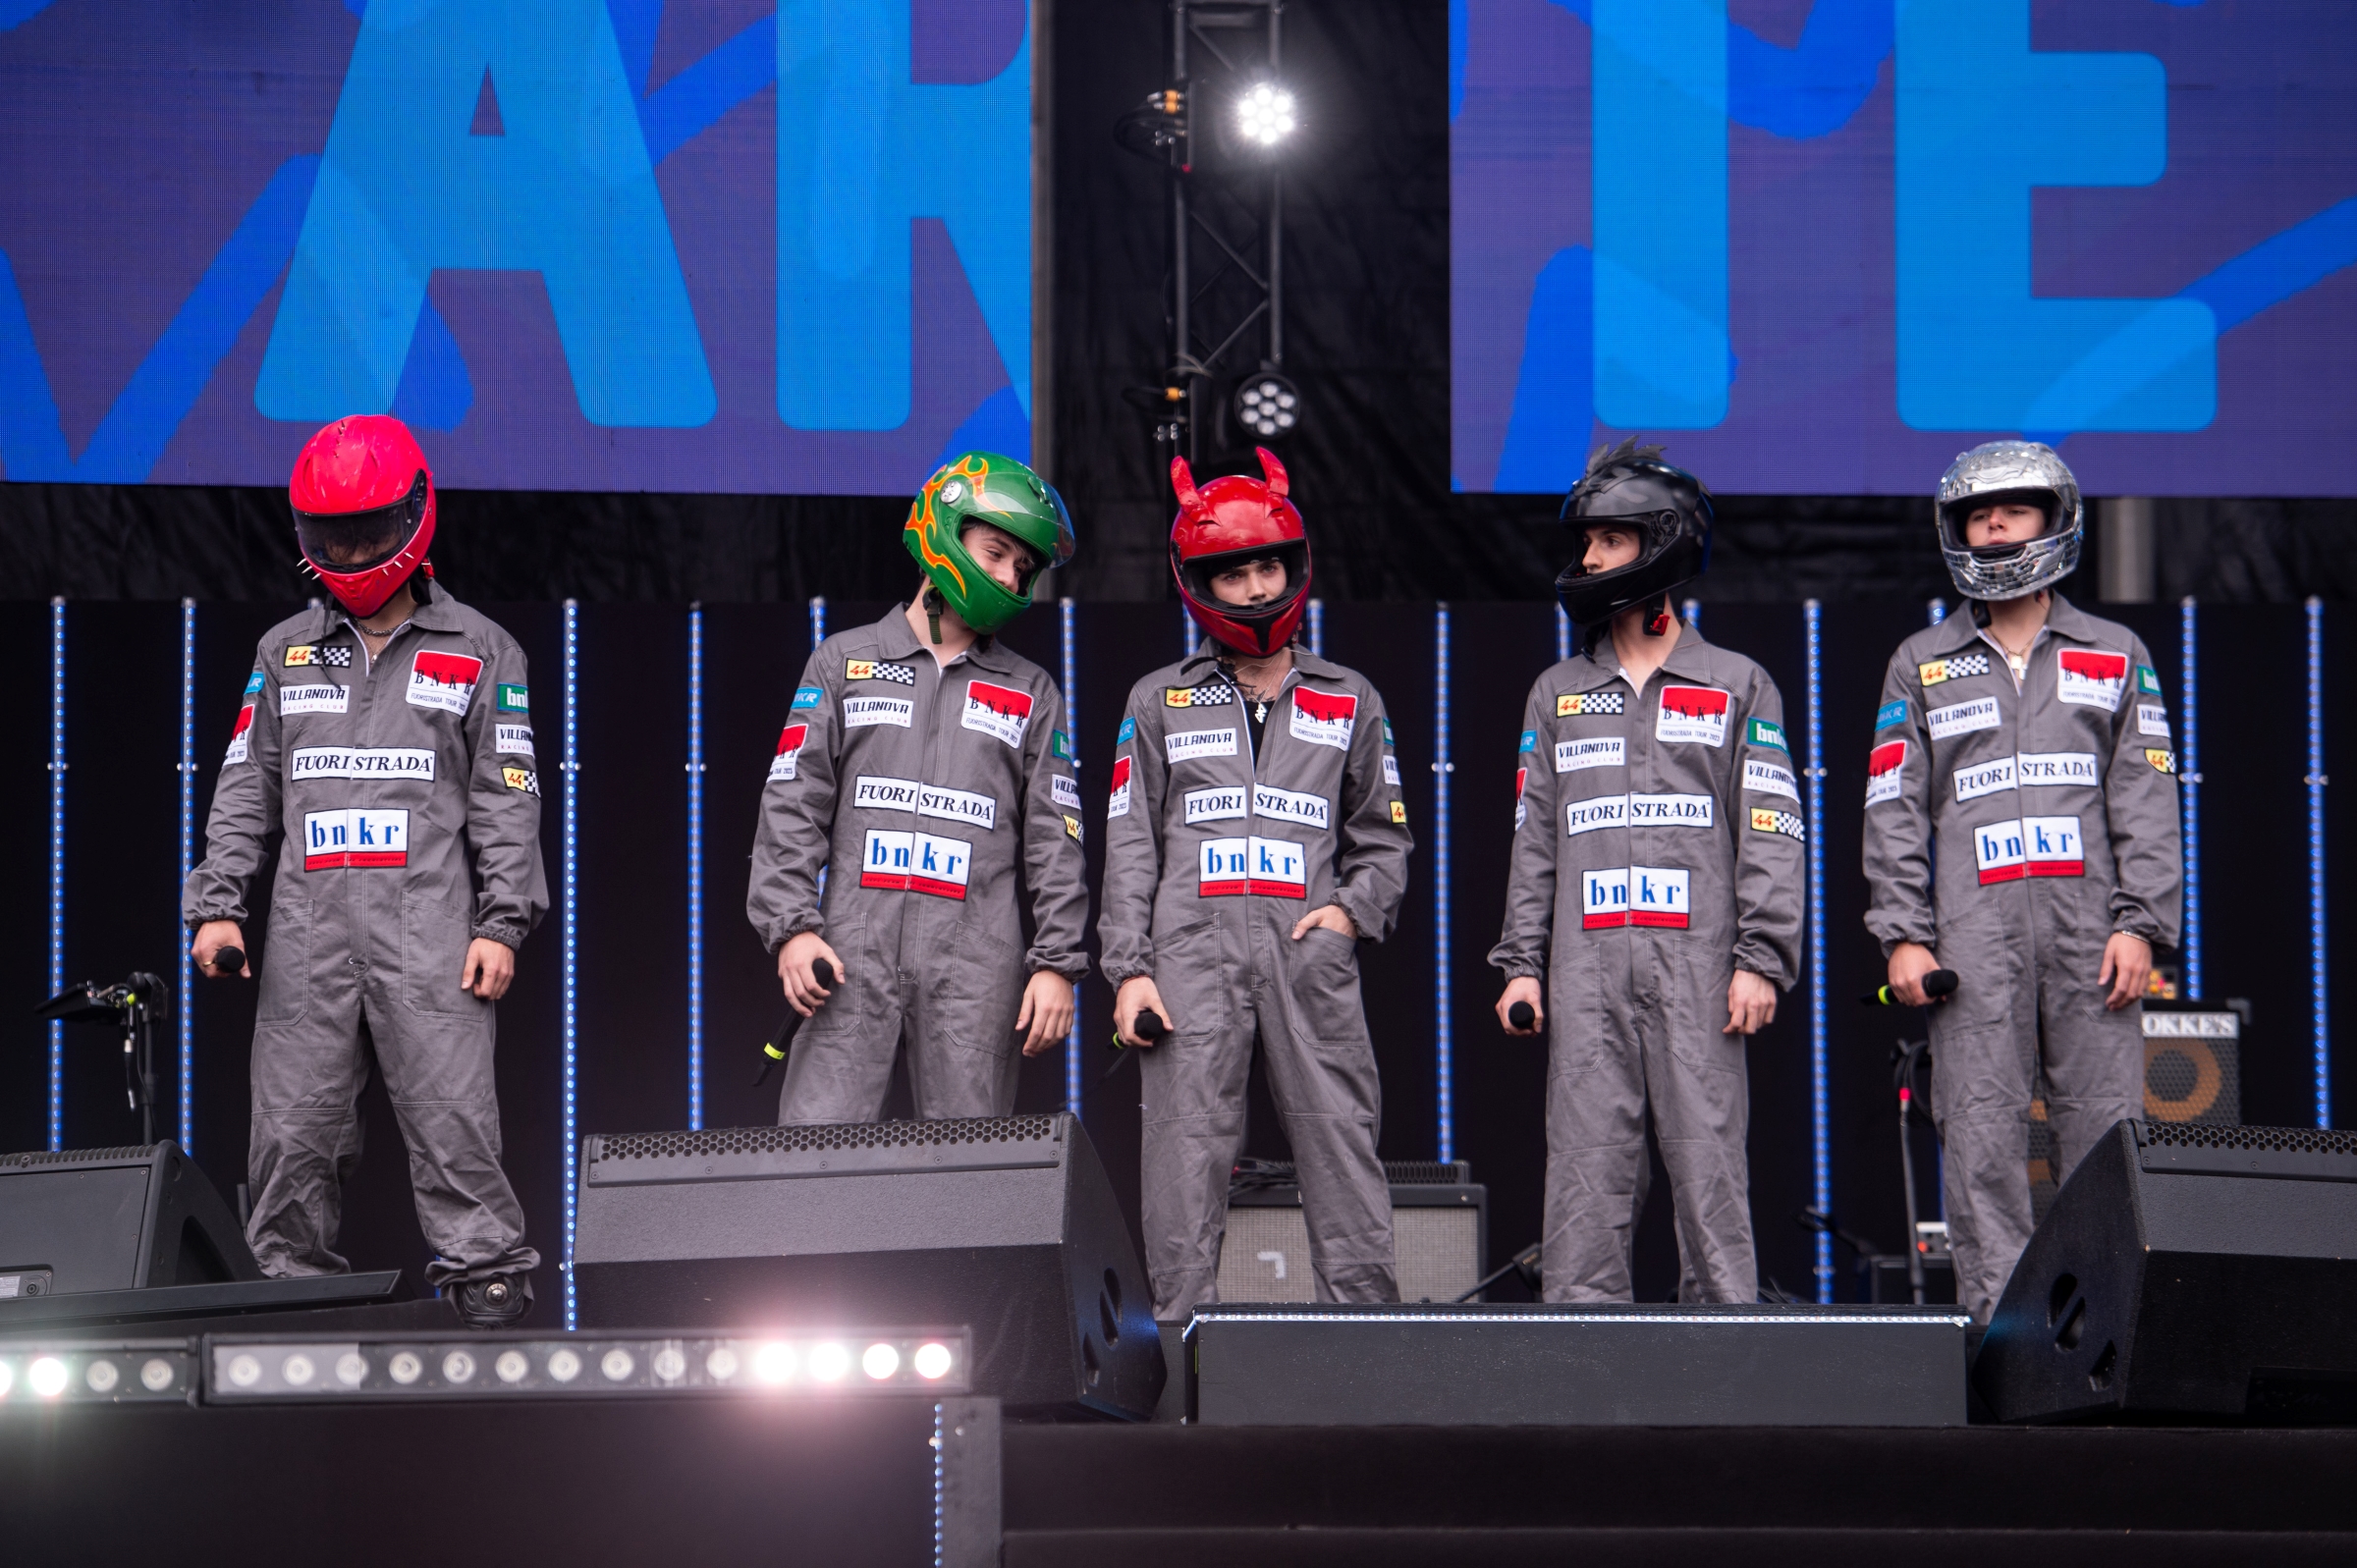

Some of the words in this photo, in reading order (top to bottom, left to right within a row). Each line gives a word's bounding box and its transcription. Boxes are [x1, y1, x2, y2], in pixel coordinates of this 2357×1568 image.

[288, 650, 308, 662] 44
[850, 665, 870, 676] 44
[1924, 666, 1943, 679] 44
[2063, 667, 2121, 689] BNKR
[414, 669, 474, 696] BNKR
[283, 688, 346, 702] VILLANOVA
[1169, 693, 1188, 704] 44
[1560, 699, 1579, 711] 44
[847, 701, 909, 715] VILLANOVA
[969, 696, 1026, 729] BNKR
[1295, 703, 1351, 730] BNKR
[1663, 704, 1723, 726] BNKR
[1929, 702, 1993, 727] VILLANOVA
[1168, 732, 1233, 750] VILLANOVA
[1559, 741, 1620, 759] VILLANOVA
[508, 773, 522, 786] 44
[1958, 766, 2012, 792] FUORI
[2020, 761, 2093, 777] STRADA
[858, 784, 915, 804] FUORI
[920, 792, 992, 821] STRADA
[1188, 795, 1242, 815] FUORI
[1255, 792, 1325, 821] STRADA
[1571, 804, 1624, 826] FUORI
[1631, 802, 1709, 819] STRADA
[310, 816, 399, 848] bnkr
[1754, 814, 1772, 827] 44
[1981, 825, 2073, 861] bnkr
[871, 838, 962, 876] bnkr
[1207, 845, 1297, 876] bnkr
[1590, 875, 1680, 906] bnkr
